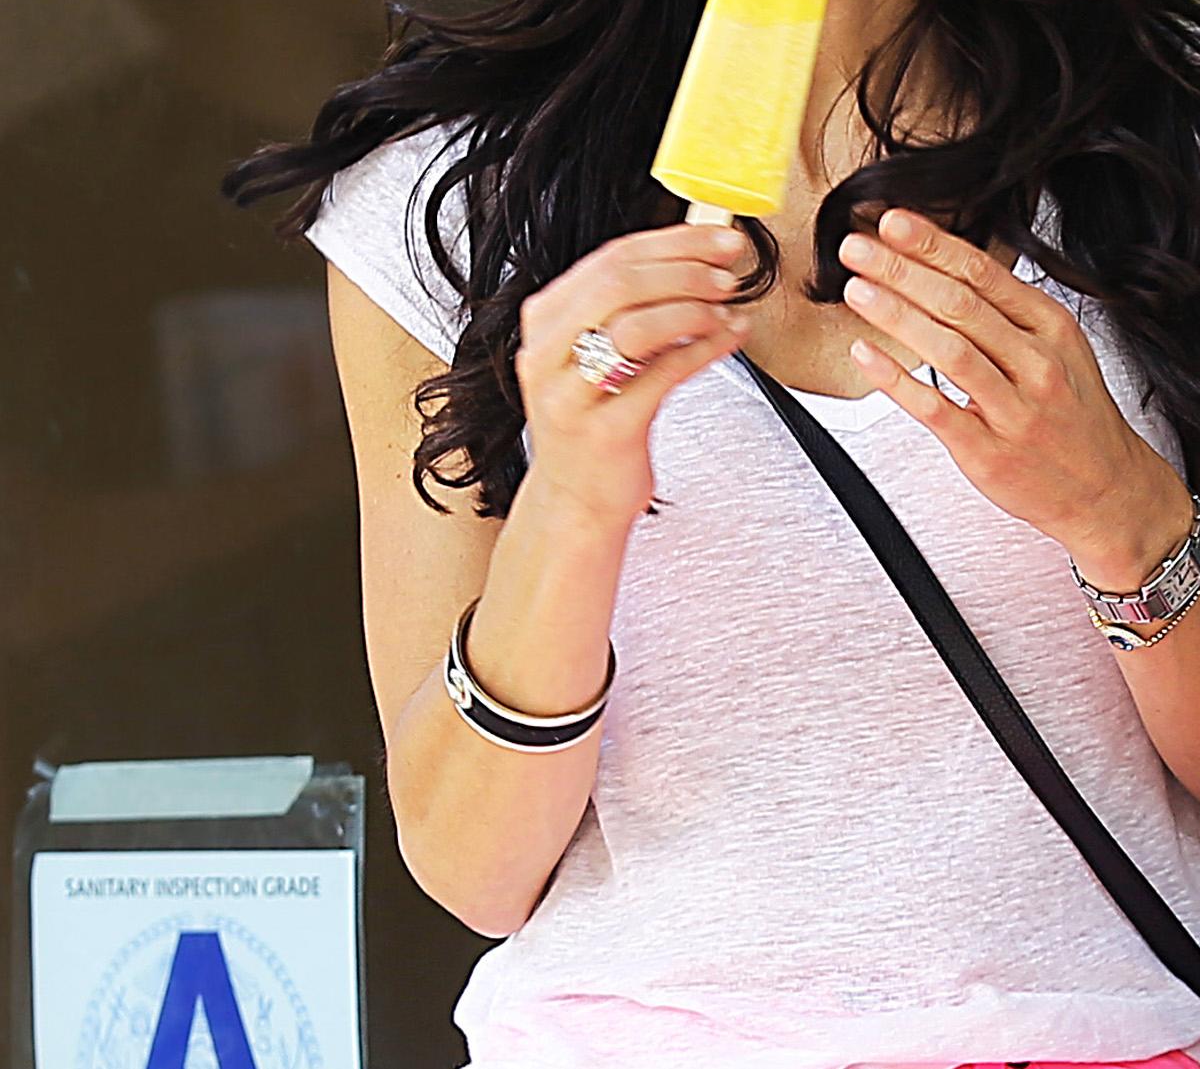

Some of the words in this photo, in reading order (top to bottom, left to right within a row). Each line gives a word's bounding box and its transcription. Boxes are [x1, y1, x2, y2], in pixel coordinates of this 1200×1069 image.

[65, 877, 149, 897] SANITARY
[155, 876, 257, 897] INSPECTION
[263, 876, 321, 897] GRADE
[146, 930, 258, 1069] A
